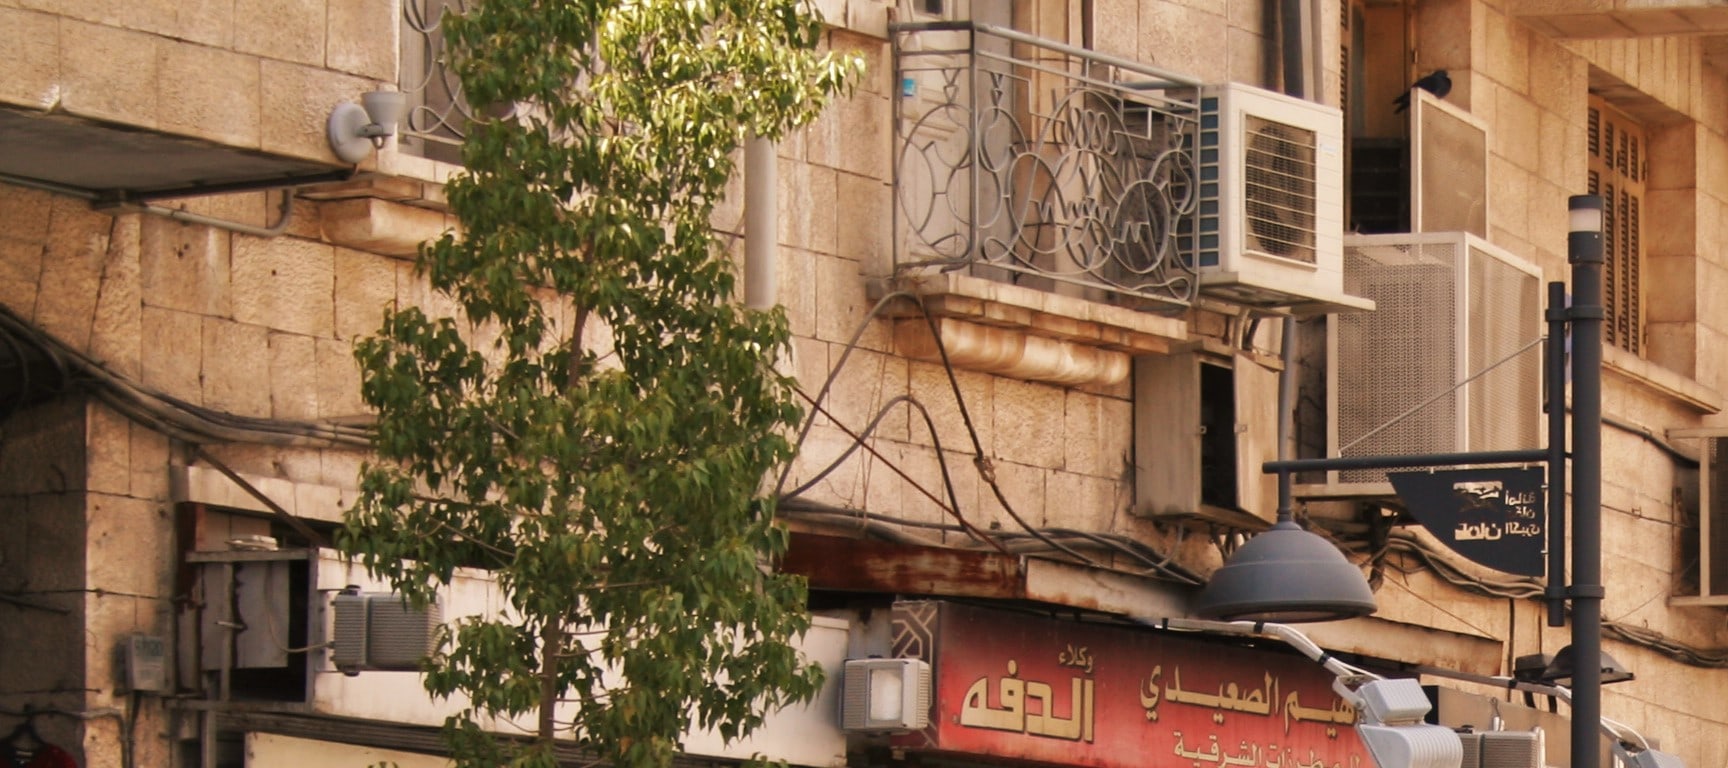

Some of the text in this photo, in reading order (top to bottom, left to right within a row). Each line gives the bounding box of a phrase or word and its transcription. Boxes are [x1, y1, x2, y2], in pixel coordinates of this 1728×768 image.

[1059, 644, 1094, 673] وكلاء
[1141, 665, 1281, 724] الصعيدي
[1174, 731, 1262, 768] الشرقية
